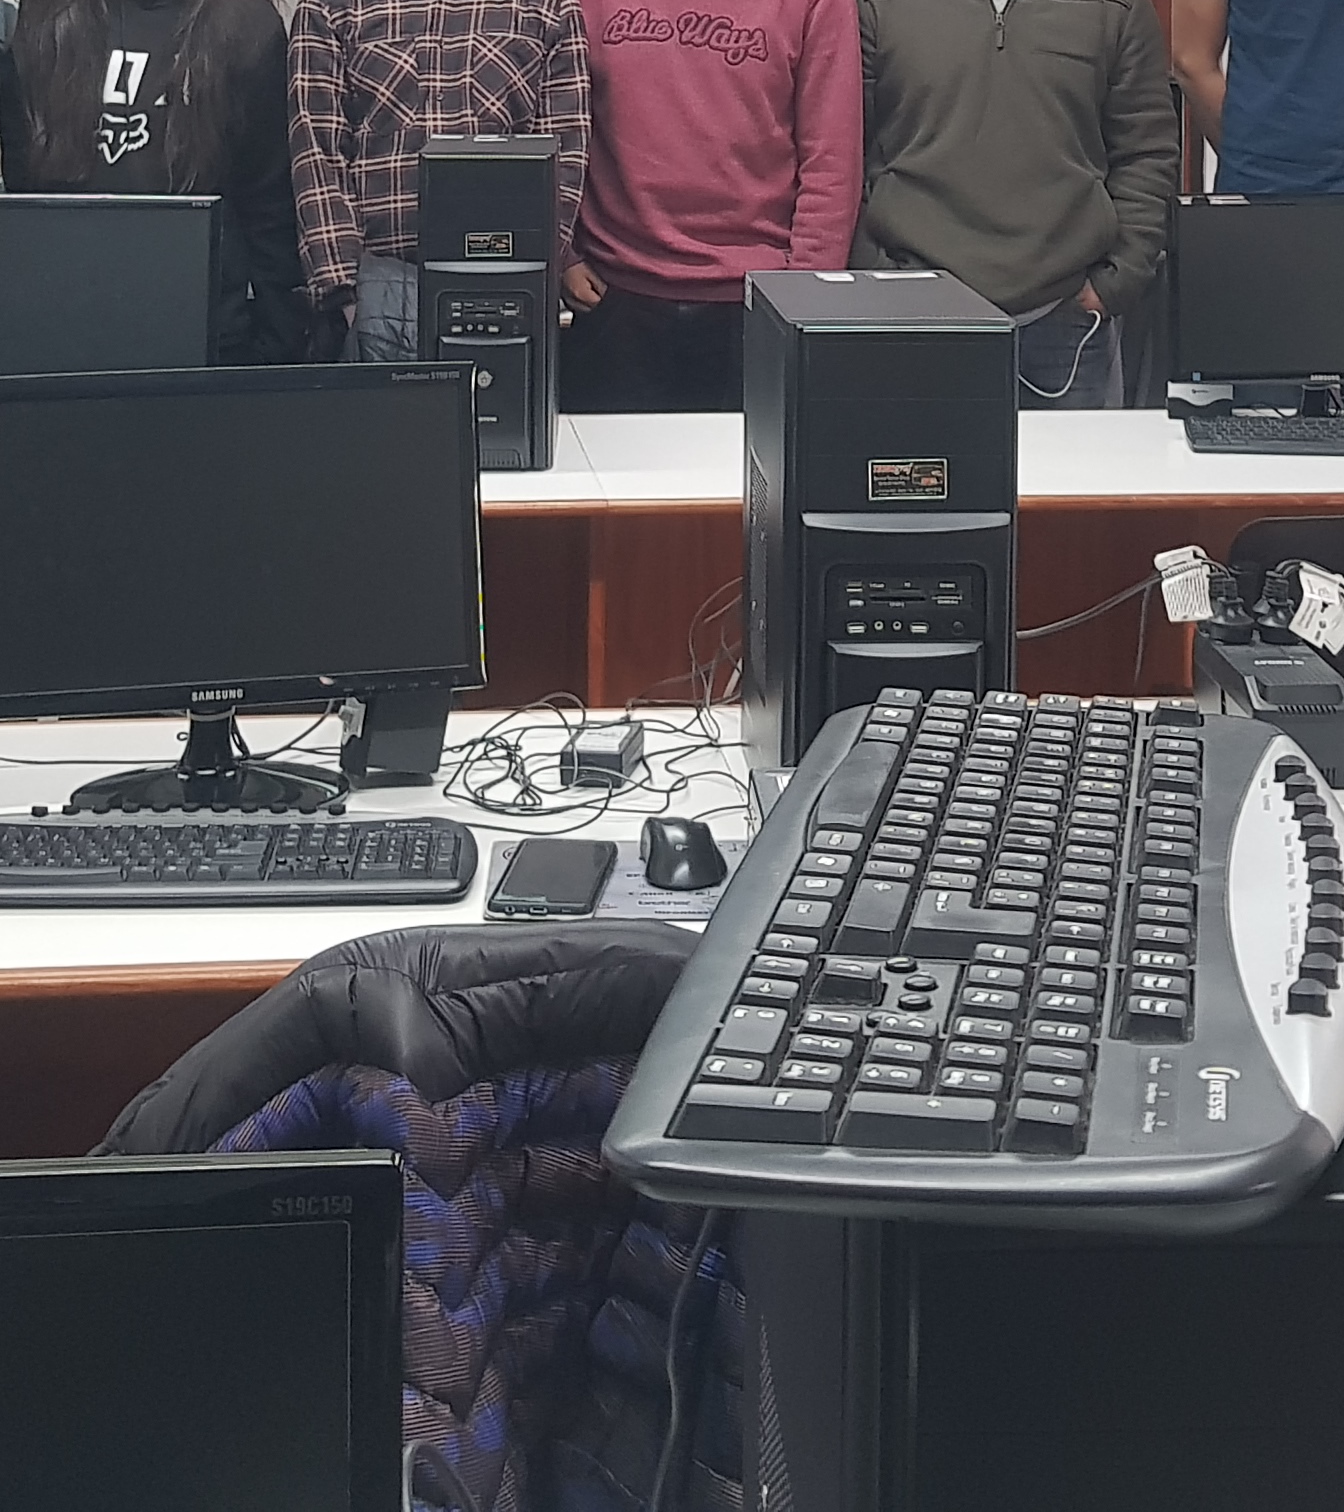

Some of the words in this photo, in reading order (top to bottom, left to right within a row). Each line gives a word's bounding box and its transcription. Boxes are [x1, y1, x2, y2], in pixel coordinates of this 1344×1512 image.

[603, 8, 674, 44] Blue
[677, 11, 768, 65] Ways
[191, 688, 244, 702] SAMSUNG
